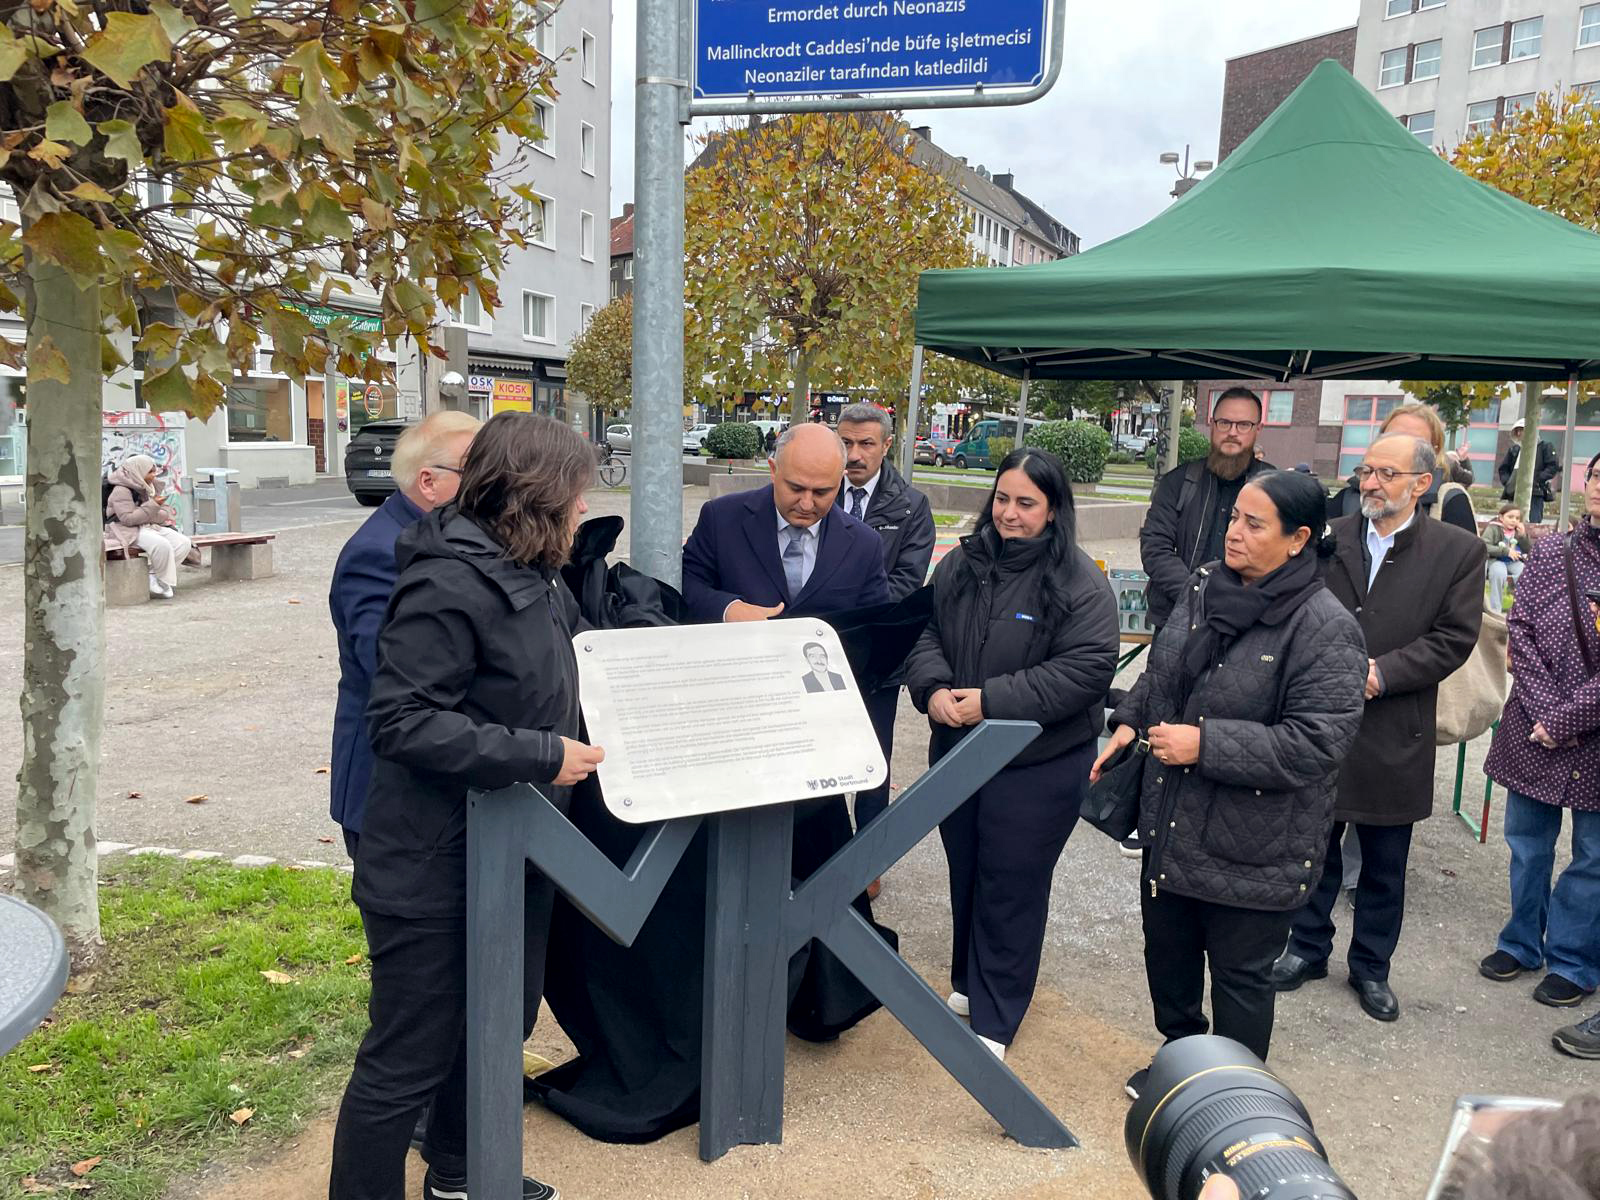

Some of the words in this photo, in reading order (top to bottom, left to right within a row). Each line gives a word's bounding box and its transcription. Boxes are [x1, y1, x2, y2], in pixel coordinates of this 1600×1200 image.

[768, 5, 839, 23] Ermordet
[843, 1, 888, 19] durch
[893, 0, 966, 16] Neonazis
[707, 41, 802, 61] Mallinckrodt
[905, 33, 941, 51] büfe
[945, 28, 1032, 52] işletmecisi
[745, 65, 826, 84] Neonaziler
[829, 61, 910, 81] tarafından
[914, 56, 988, 76] katledildi
[471, 376, 493, 387] OSK
[498, 383, 528, 394] KIOSK
[819, 777, 838, 790] DO
[1223, 1140, 1249, 1159] Nikon
